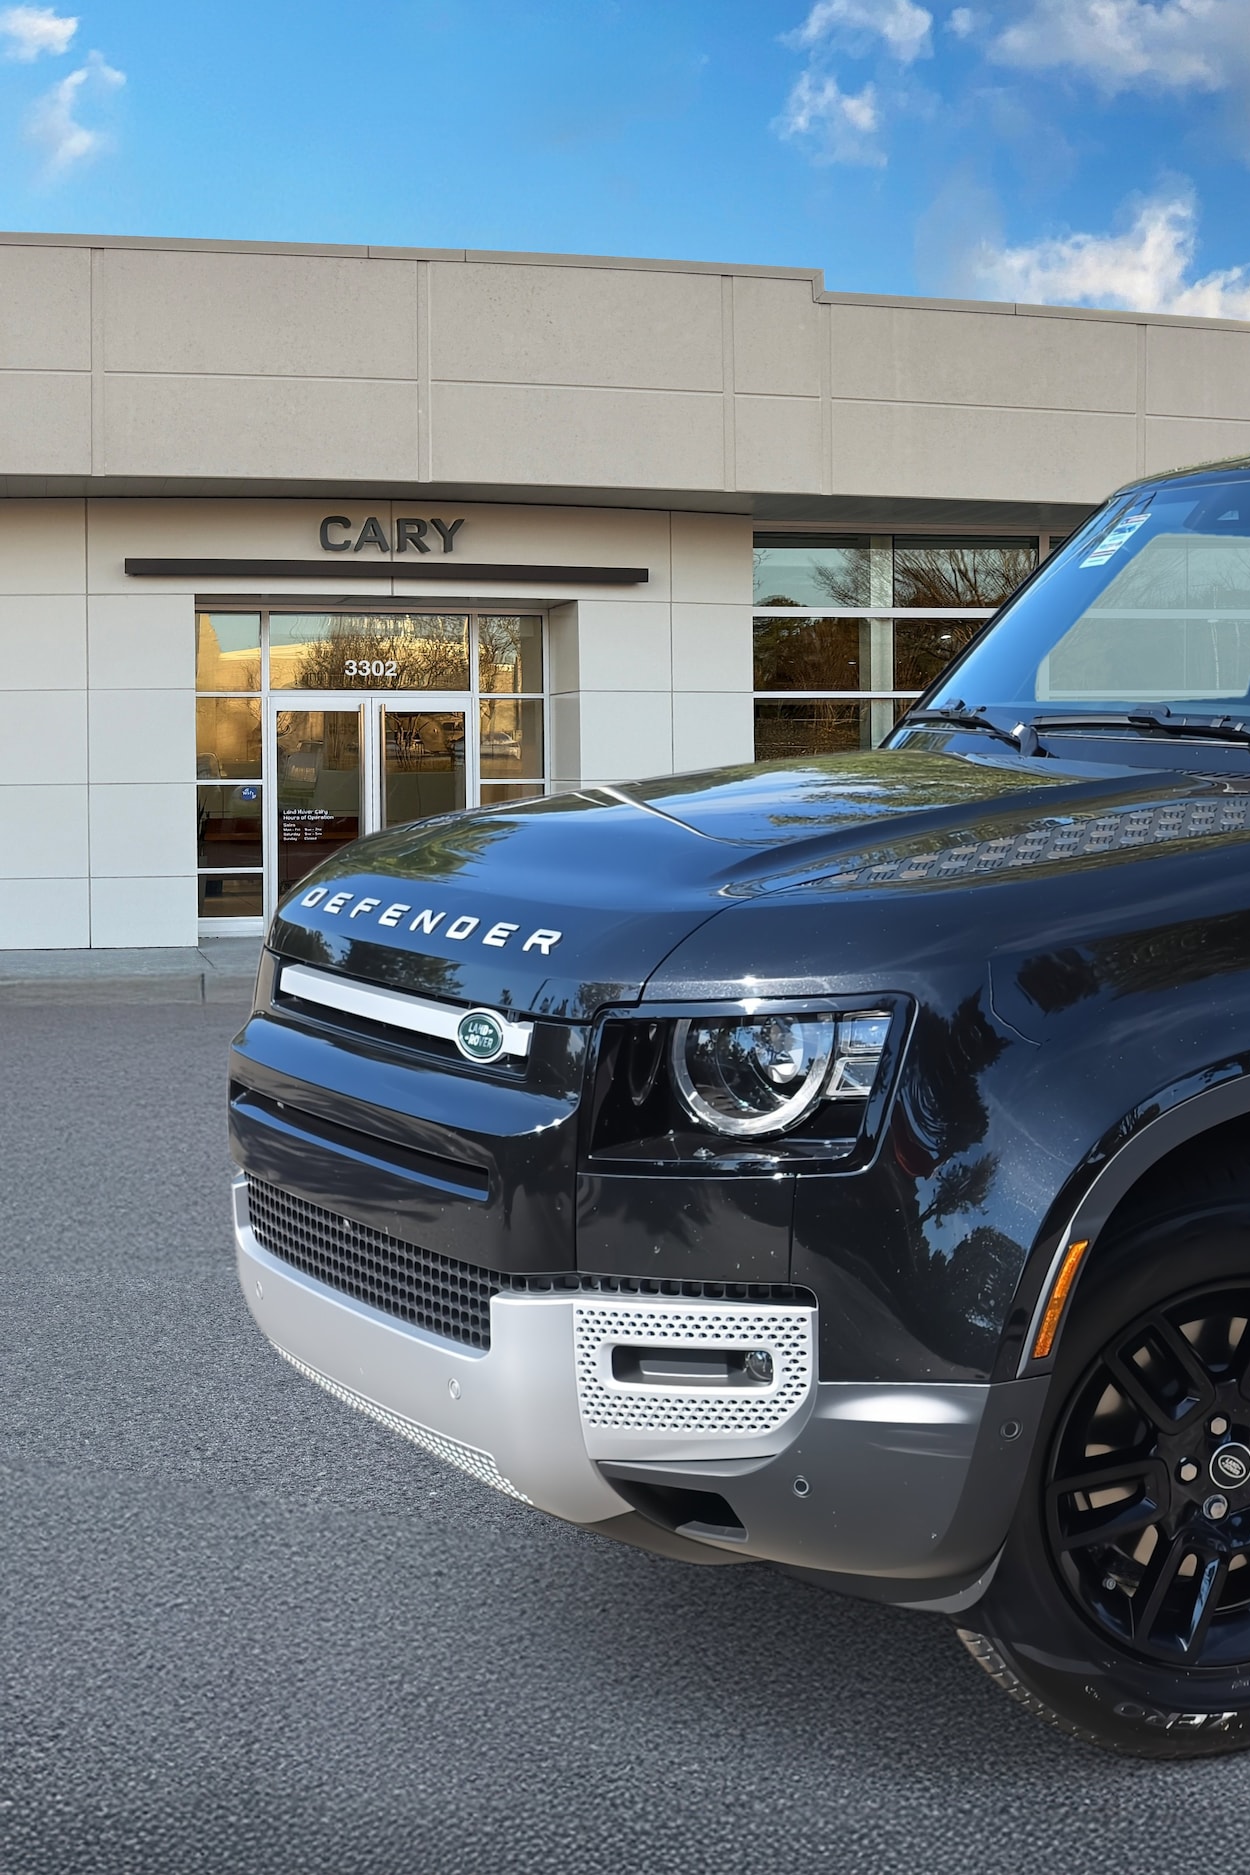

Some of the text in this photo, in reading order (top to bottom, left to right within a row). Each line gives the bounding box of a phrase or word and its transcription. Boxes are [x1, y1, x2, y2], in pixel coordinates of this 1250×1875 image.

[319, 515, 466, 554] CARY
[344, 660, 398, 677] 3302
[300, 887, 562, 956] DEFENDER
[468, 1022, 490, 1036] LAND
[467, 1034, 494, 1049] ROVER
